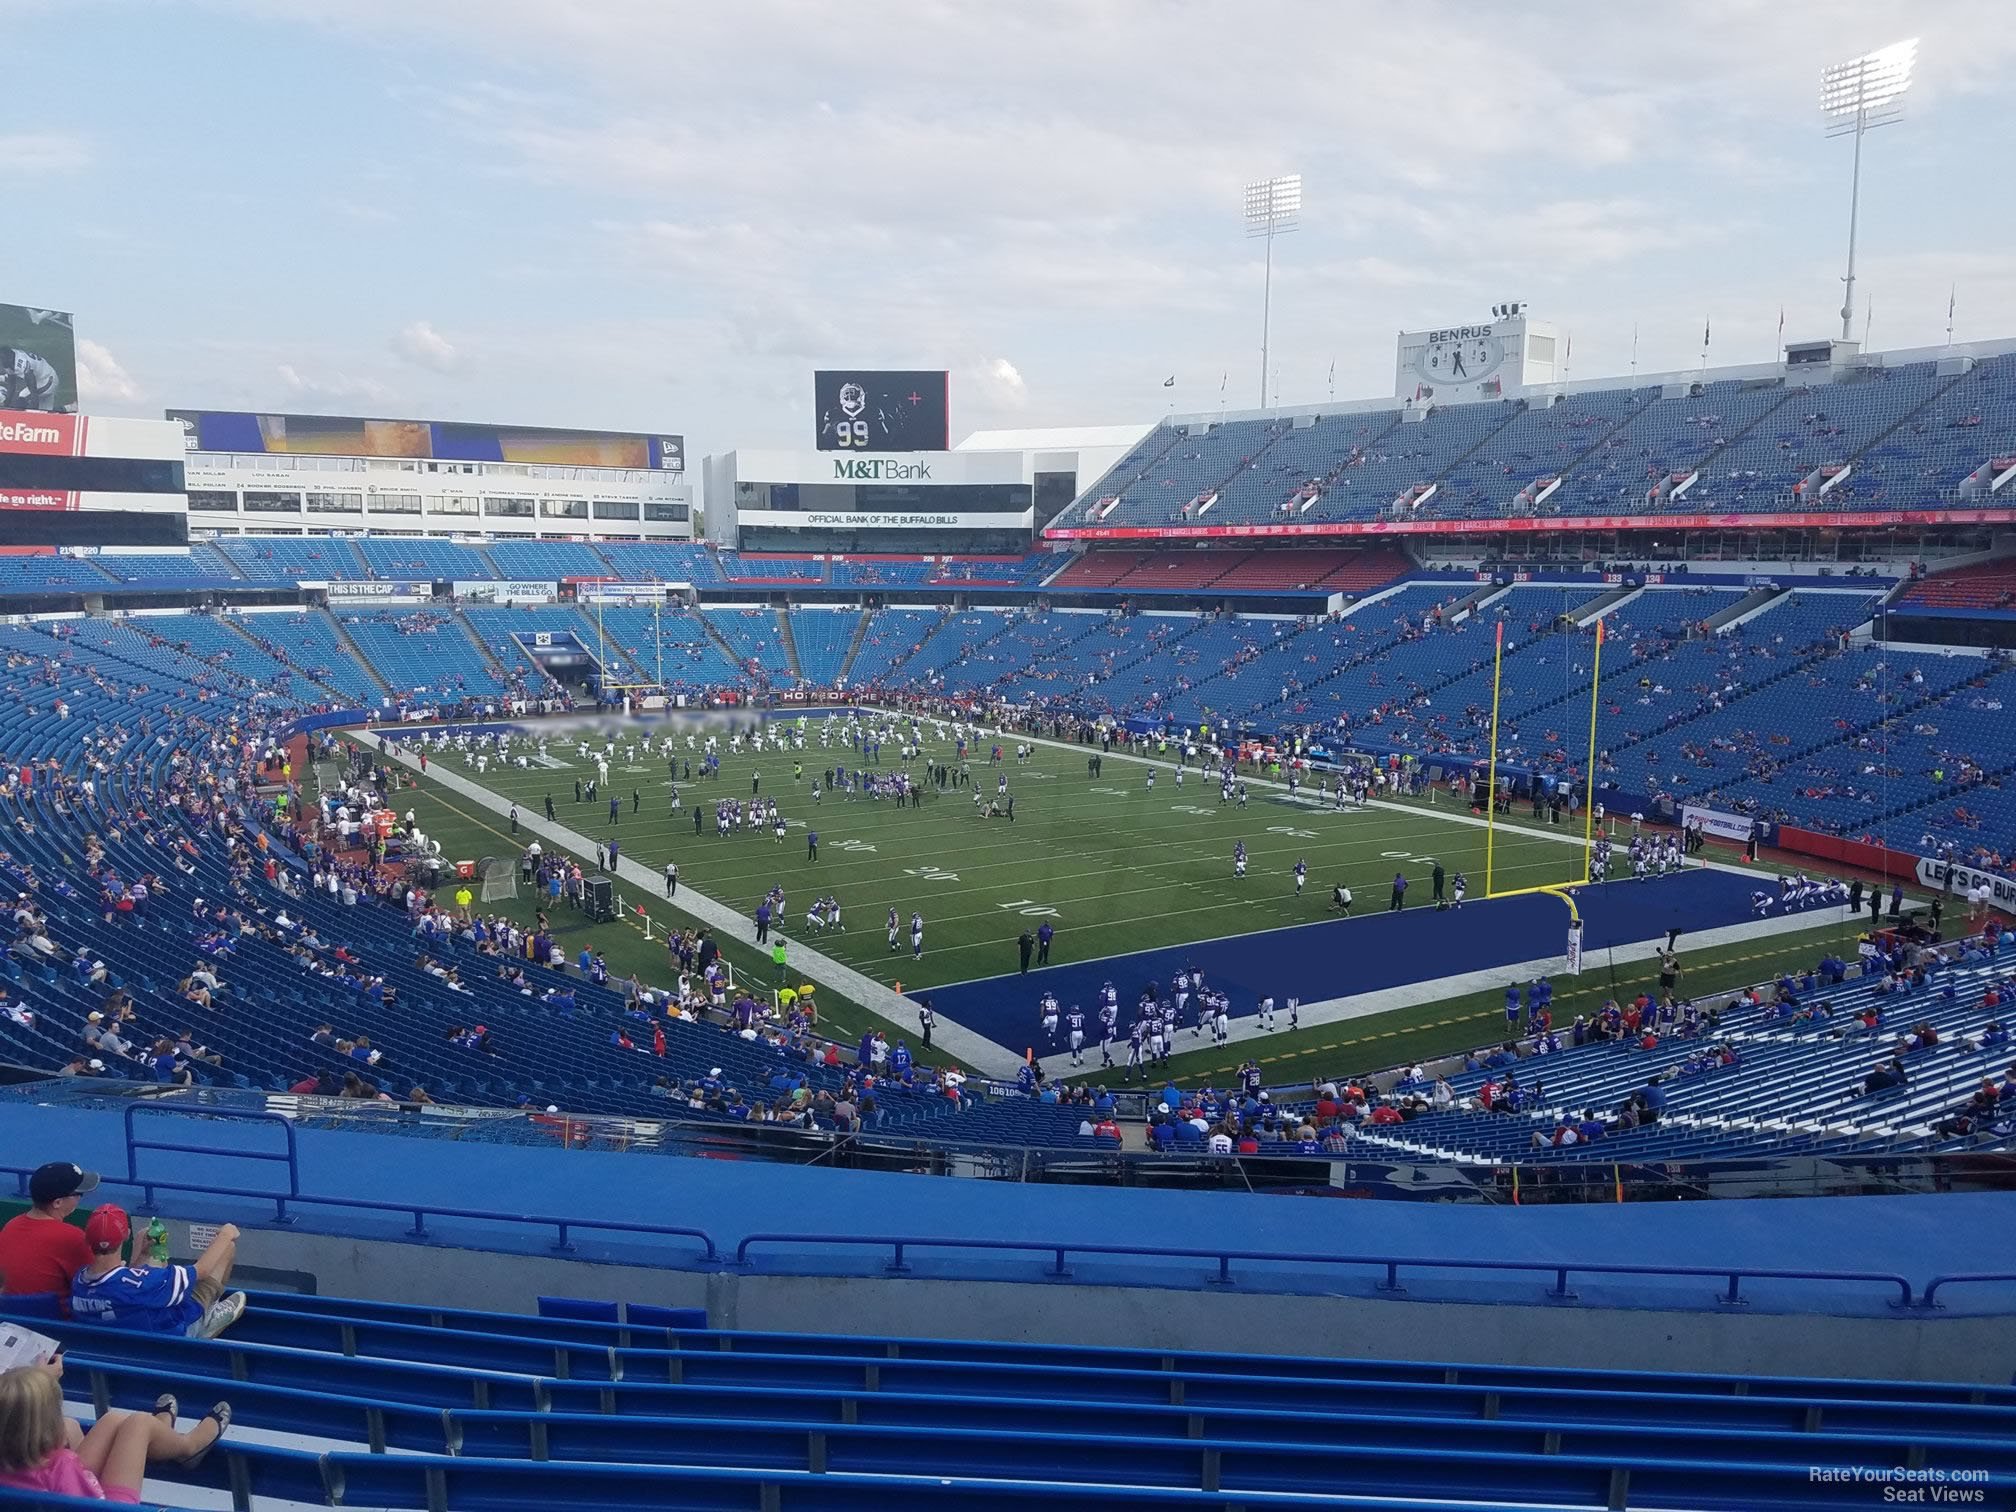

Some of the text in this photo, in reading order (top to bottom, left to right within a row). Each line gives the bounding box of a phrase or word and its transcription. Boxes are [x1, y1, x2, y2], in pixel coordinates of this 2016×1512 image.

[1429, 325, 1492, 343] BENRUS
[1431, 356, 1439, 368] 9
[1479, 351, 1487, 363] 3
[836, 420, 869, 447] 99
[833, 459, 932, 479] M&T Bank
[11, 495, 25, 507] go
[808, 514, 958, 524] OFFICIAL BANK OF THE BUFFALO BILLS
[1479, 573, 1492, 581] 132
[1513, 573, 1527, 581] 133
[1607, 574, 1622, 582] 133
[1645, 575, 1660, 583] 134
[329, 584, 394, 594] THIS IS THE CAP
[1072, 1018, 1081, 1027] 91
[897, 1054, 907, 1065] 12
[1249, 1076, 1260, 1086] 28
[989, 1087, 1004, 1095] 106
[121, 1267, 150, 1289] 14
